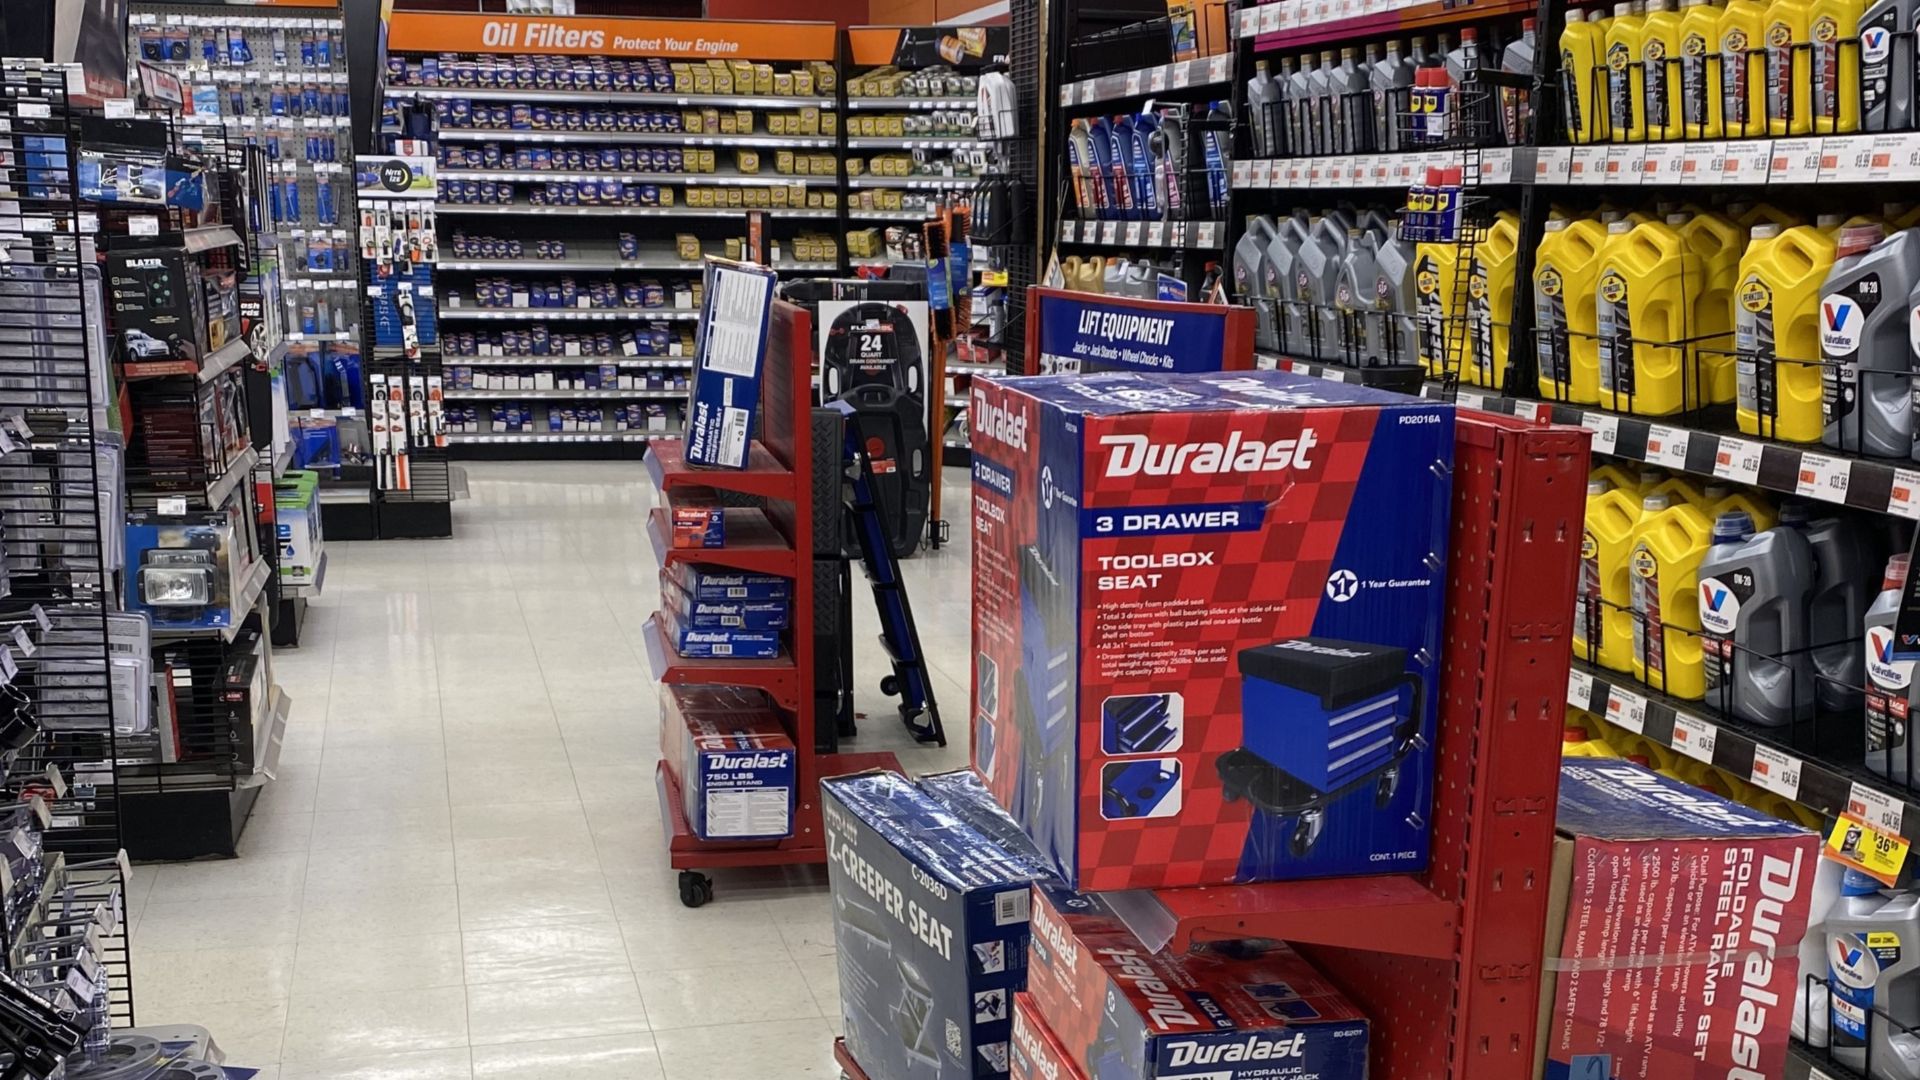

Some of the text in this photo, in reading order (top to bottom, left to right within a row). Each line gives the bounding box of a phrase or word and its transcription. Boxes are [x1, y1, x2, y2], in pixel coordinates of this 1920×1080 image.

[483, 22, 739, 54] Oil Filters Protect Your Engine
[993, 54, 1010, 64] FRA
[126, 258, 163, 268] BLAZER
[1376, 281, 1388, 294] STP
[1859, 282, 1878, 294] 0W-20
[1078, 310, 1174, 346] LIFT EQUIPMENT
[860, 334, 882, 352] 24
[1824, 334, 1852, 345] Valvoline
[1072, 342, 1174, 368] Jacks Jack Stands Wheel Chocks Kits
[974, 394, 1028, 453] Duralast
[1398, 414, 1442, 425] PD2016A
[690, 401, 710, 460] Duralast
[710, 407, 723, 464] CREEPER SEAT
[704, 418, 716, 464] PNEUMATIC
[1099, 427, 1318, 478] Duralast
[975, 462, 1011, 494] 3 DRAWER
[976, 496, 1006, 525] TOOLBOX
[976, 516, 993, 536] SEAT
[1096, 511, 1240, 532] 3 DRAWER
[1098, 551, 1214, 571] TOOLBOX
[701, 576, 744, 586] Duralast
[1098, 574, 1162, 591] SEAT
[1362, 576, 1431, 589] 1 Year Guarantee
[1734, 574, 1752, 586] 0W-20
[696, 604, 738, 614] Duralast
[1102, 603, 1118, 611] High
[1120, 601, 1144, 609] density
[1145, 600, 1162, 608] foam
[1163, 599, 1189, 608] padded
[1183, 609, 1208, 617] bearing
[1704, 612, 1729, 626] Valvoline
[686, 632, 730, 642] Duralast
[1275, 640, 1375, 659] Duralast
[1871, 662, 1902, 680] Valvoline
[707, 752, 788, 770] Duralast
[732, 772, 754, 780] LBS
[1595, 767, 1779, 827] Duralast
[1370, 852, 1390, 862] CONT.
[1398, 850, 1418, 860] PIECE
[1671, 856, 1680, 872] 750
[911, 864, 948, 902] C-2036D
[828, 828, 904, 924] Z-CREEPER
[908, 900, 953, 961] SEAT
[1662, 888, 1675, 922] capacity
[1720, 848, 1754, 977] FOLDABLE
[1580, 905, 1590, 929] STEEL
[1034, 894, 1078, 976] Duralast
[1661, 924, 1669, 938] per
[1036, 940, 1047, 961] TON
[1574, 930, 1586, 958] RAMPS
[1656, 942, 1665, 963] ramp
[1693, 848, 1738, 1061] STEEL RAMP SET
[1654, 966, 1663, 988] when
[1096, 948, 1199, 1031] Duralast
[1196, 998, 1224, 1019] TON
[1566, 987, 1576, 1017] SAFETY
[1650, 990, 1659, 1010] used
[1648, 1012, 1655, 1022] as
[1561, 1018, 1572, 1050] CHAINS
[1646, 1024, 1653, 1034] an
[1014, 1004, 1059, 1080] Duralast
[1166, 1033, 1306, 1068] Duralast
[1643, 1036, 1653, 1054] ATV
[1238, 1066, 1302, 1078] HYDRAULIC
[1639, 1056, 1649, 1078] ramp
